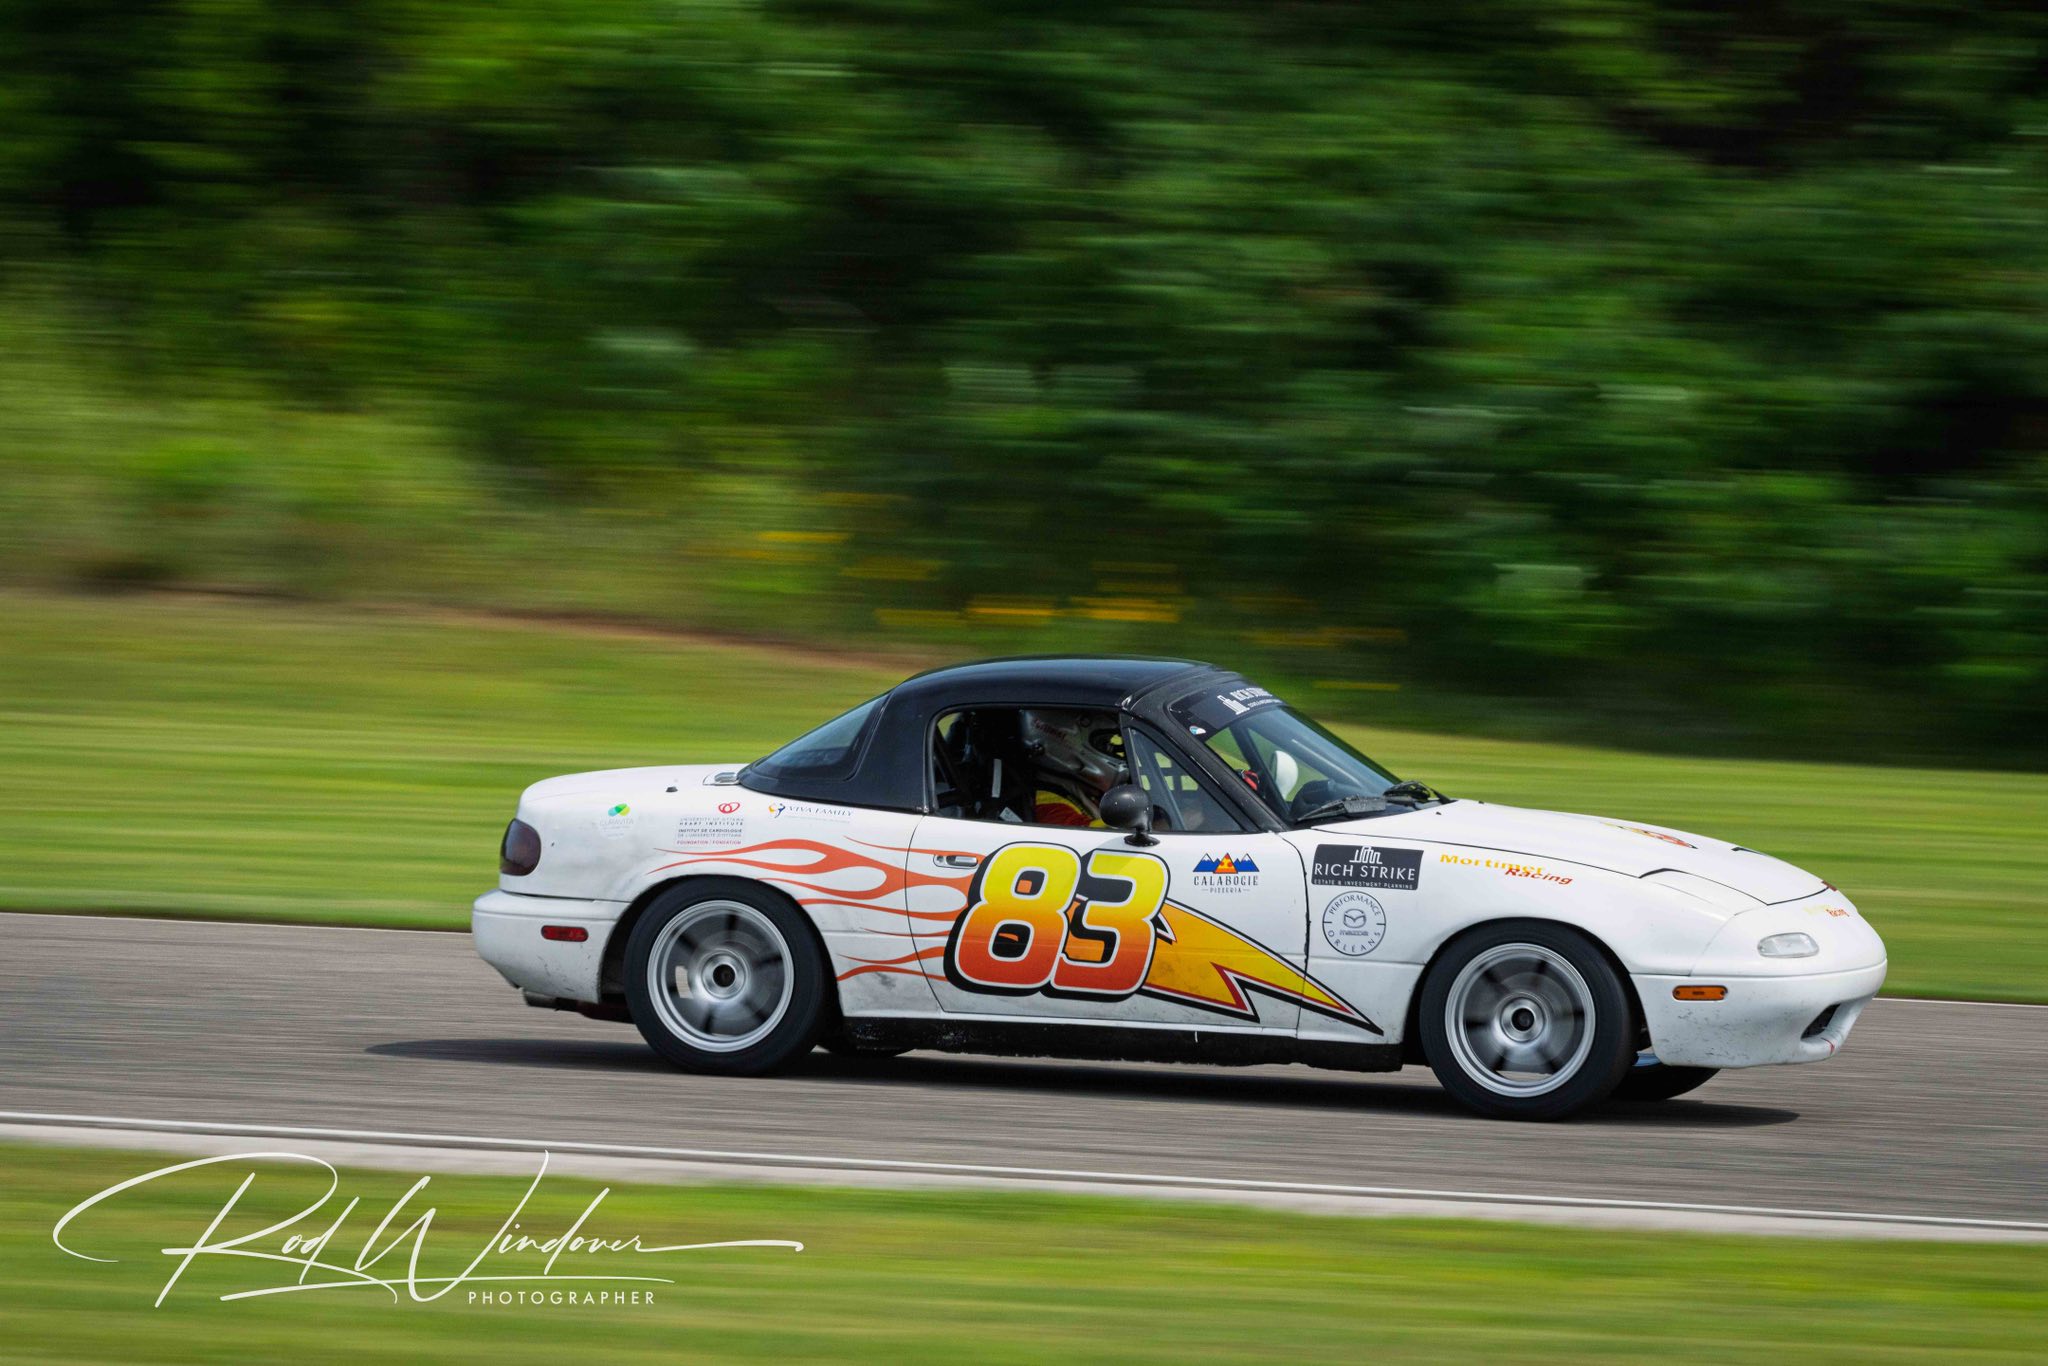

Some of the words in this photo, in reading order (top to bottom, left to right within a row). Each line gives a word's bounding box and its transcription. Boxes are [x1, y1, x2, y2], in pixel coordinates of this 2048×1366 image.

[789, 805, 812, 813] VIVA
[815, 807, 853, 816] FAMILY
[1314, 863, 1354, 877] RICH
[1360, 865, 1416, 881] STRIKE
[1440, 854, 1547, 875] Mortimer
[1193, 875, 1258, 886] CALABOGIE
[1504, 866, 1573, 885] Racing
[1344, 880, 1381, 888] INVESTMENT
[1383, 882, 1413, 890] PLANNING
[1328, 894, 1381, 916] PERFORMANCE
[944, 841, 1171, 1003] 83
